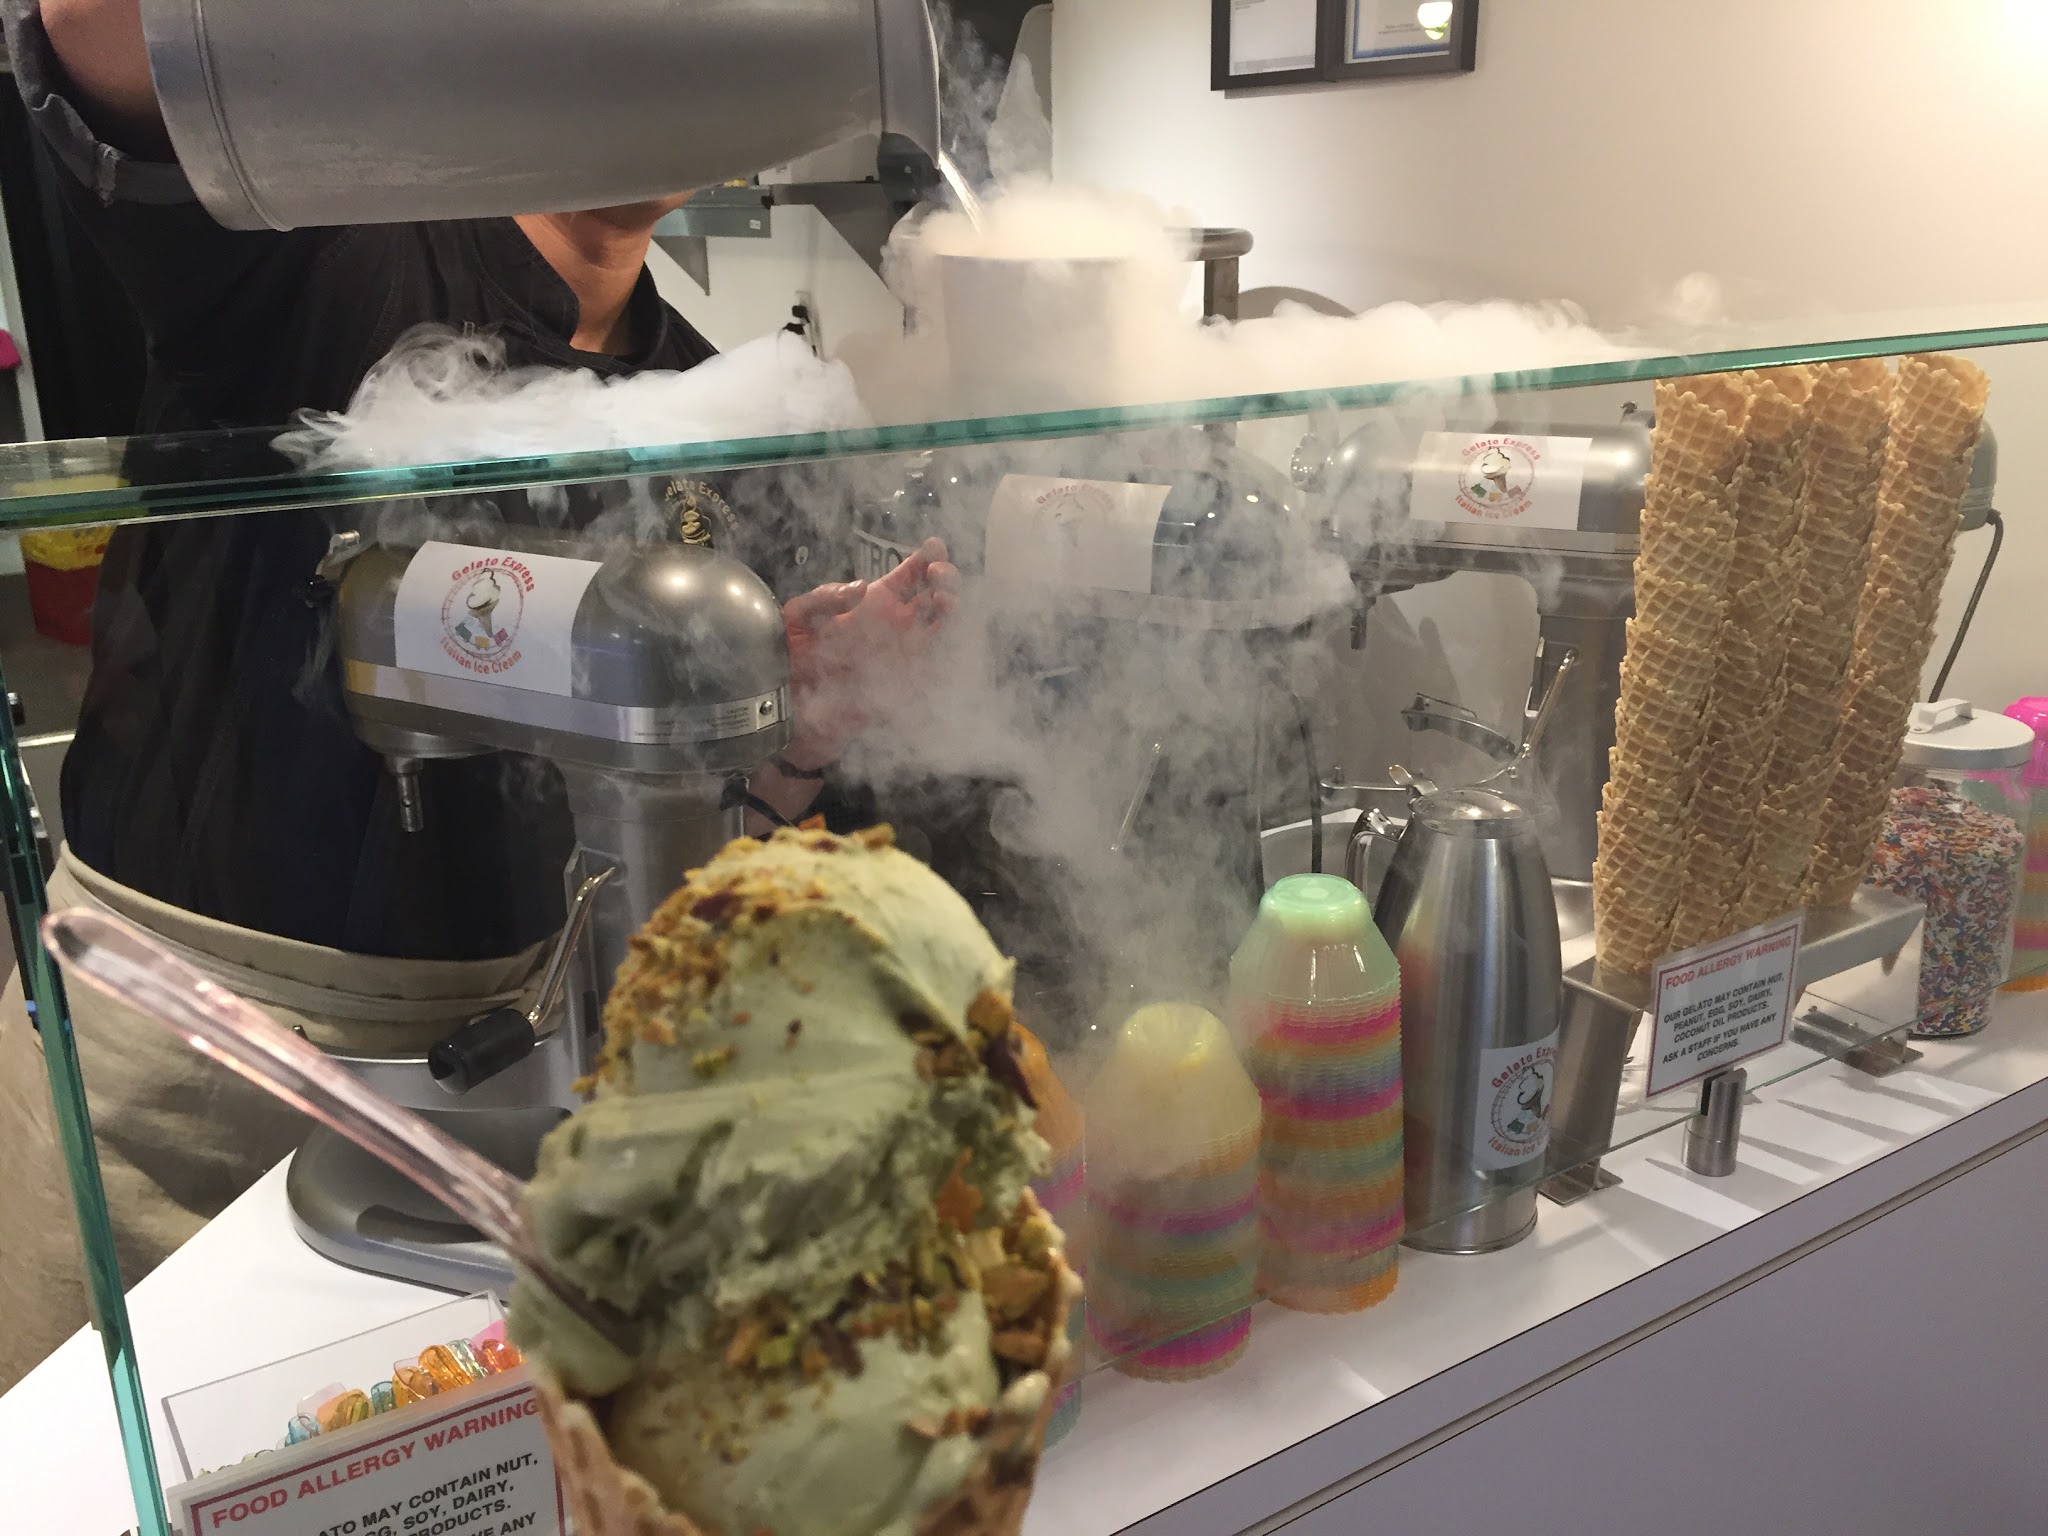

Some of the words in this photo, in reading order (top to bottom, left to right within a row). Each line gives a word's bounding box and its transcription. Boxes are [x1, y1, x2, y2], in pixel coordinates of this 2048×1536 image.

[1462, 439, 1499, 457] Gelato
[1503, 438, 1540, 460] Express
[1456, 495, 1482, 517] Italian
[451, 558, 499, 581] Gelato
[501, 557, 535, 592] Express
[440, 637, 472, 669] Italian
[473, 661, 490, 674] Ice
[491, 650, 522, 674] Cream
[1665, 971, 1694, 990] FOOD
[1697, 952, 1744, 978] ALLERGY
[1746, 936, 1792, 960] WARNING
[1663, 1010, 1681, 1024] OUR
[1682, 998, 1713, 1017] GELATO
[1714, 990, 1732, 1005] MAY
[1732, 978, 1766, 998] CONTAIN
[1662, 1052, 1679, 1064] ASK
[1680, 1048, 1687, 1057] A
[1688, 1037, 1713, 1054] STAFF
[1713, 1033, 1721, 1043] IF
[1722, 1027, 1739, 1040] YOU
[1739, 1018, 1760, 1034] HAVE
[1760, 1012, 1777, 1026] ANY
[1673, 1022, 1711, 1043] COCONUT
[1712, 1016, 1726, 1028] OIL
[1727, 1001, 1769, 1022] PRODUCTS.
[1491, 1054, 1533, 1088] Gelato
[1488, 1137, 1520, 1157] Italian
[212, 1488, 288, 1529] FOOD
[297, 1441, 416, 1499] ALLERGY
[423, 1398, 539, 1453] WARNING
[362, 1501, 403, 1528] MAY
[408, 1467, 491, 1509] CONTAIN
[496, 1452, 538, 1477] NUT,
[403, 1504, 447, 1530] SOY,
[452, 1480, 514, 1510] DAIRY,
[409, 1499, 511, 1536] RODUCTS.
[500, 1511, 537, 1536] ANY
